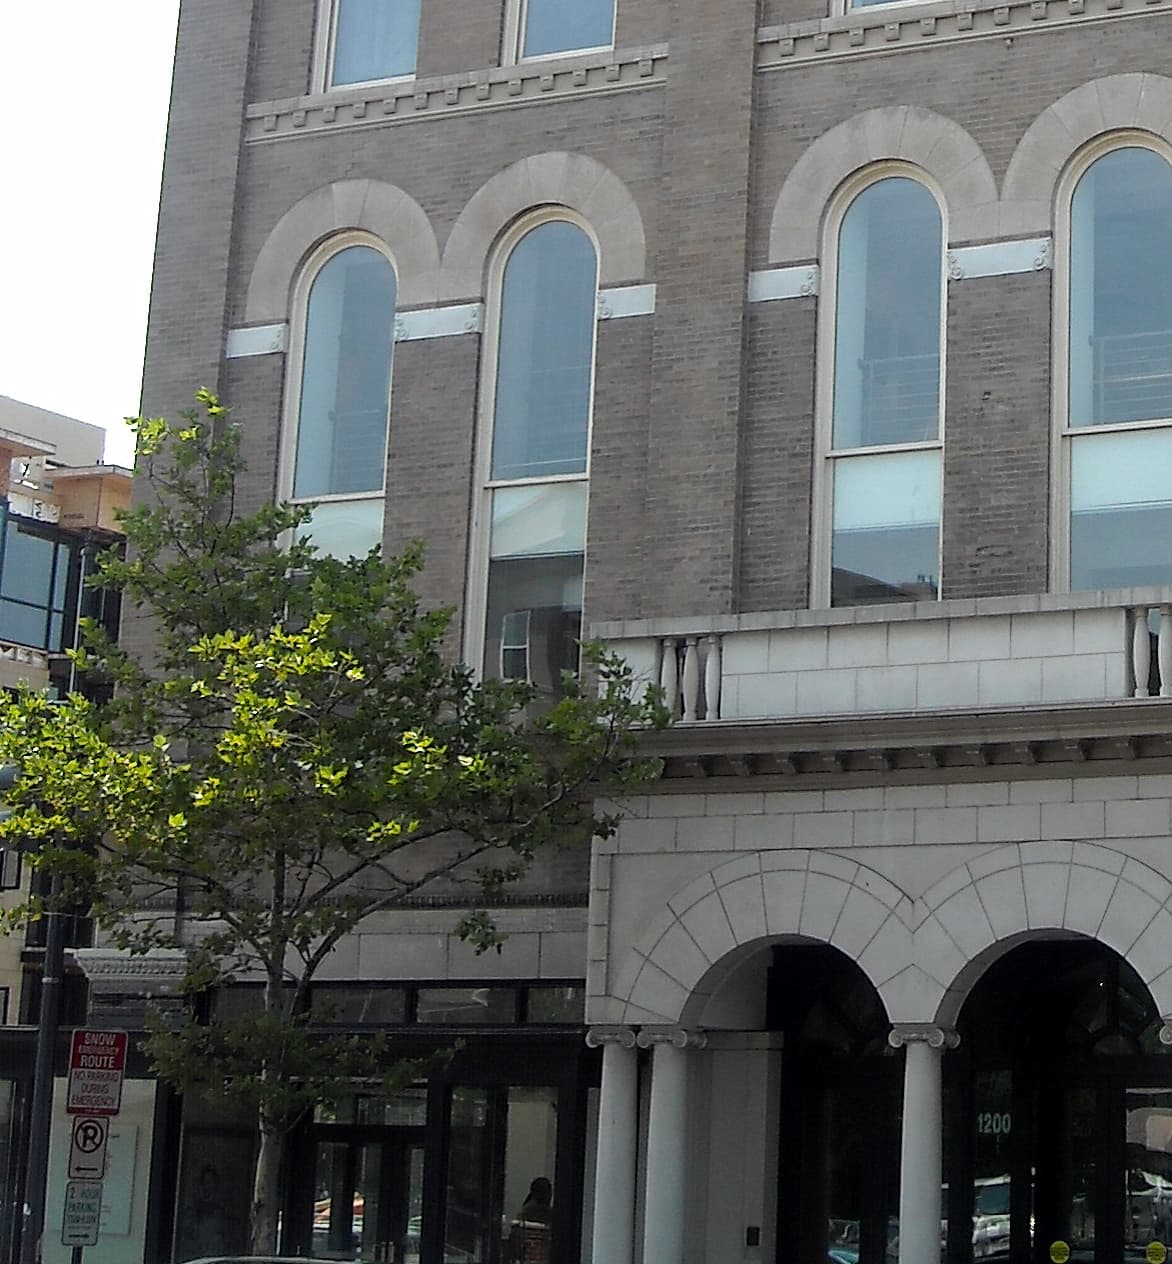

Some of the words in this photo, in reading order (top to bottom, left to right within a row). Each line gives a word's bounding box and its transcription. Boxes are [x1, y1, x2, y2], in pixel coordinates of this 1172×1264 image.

[84, 1032, 117, 1046] SNOW
[80, 1055, 115, 1068] ROUTE
[73, 1070, 86, 1081] NO
[86, 1071, 119, 1082] PARKING
[81, 1082, 109, 1094] DURING
[72, 1094, 117, 1106] EMERGENCY
[977, 1112, 1011, 1134] 1200
[69, 1187, 76, 1199] 2
